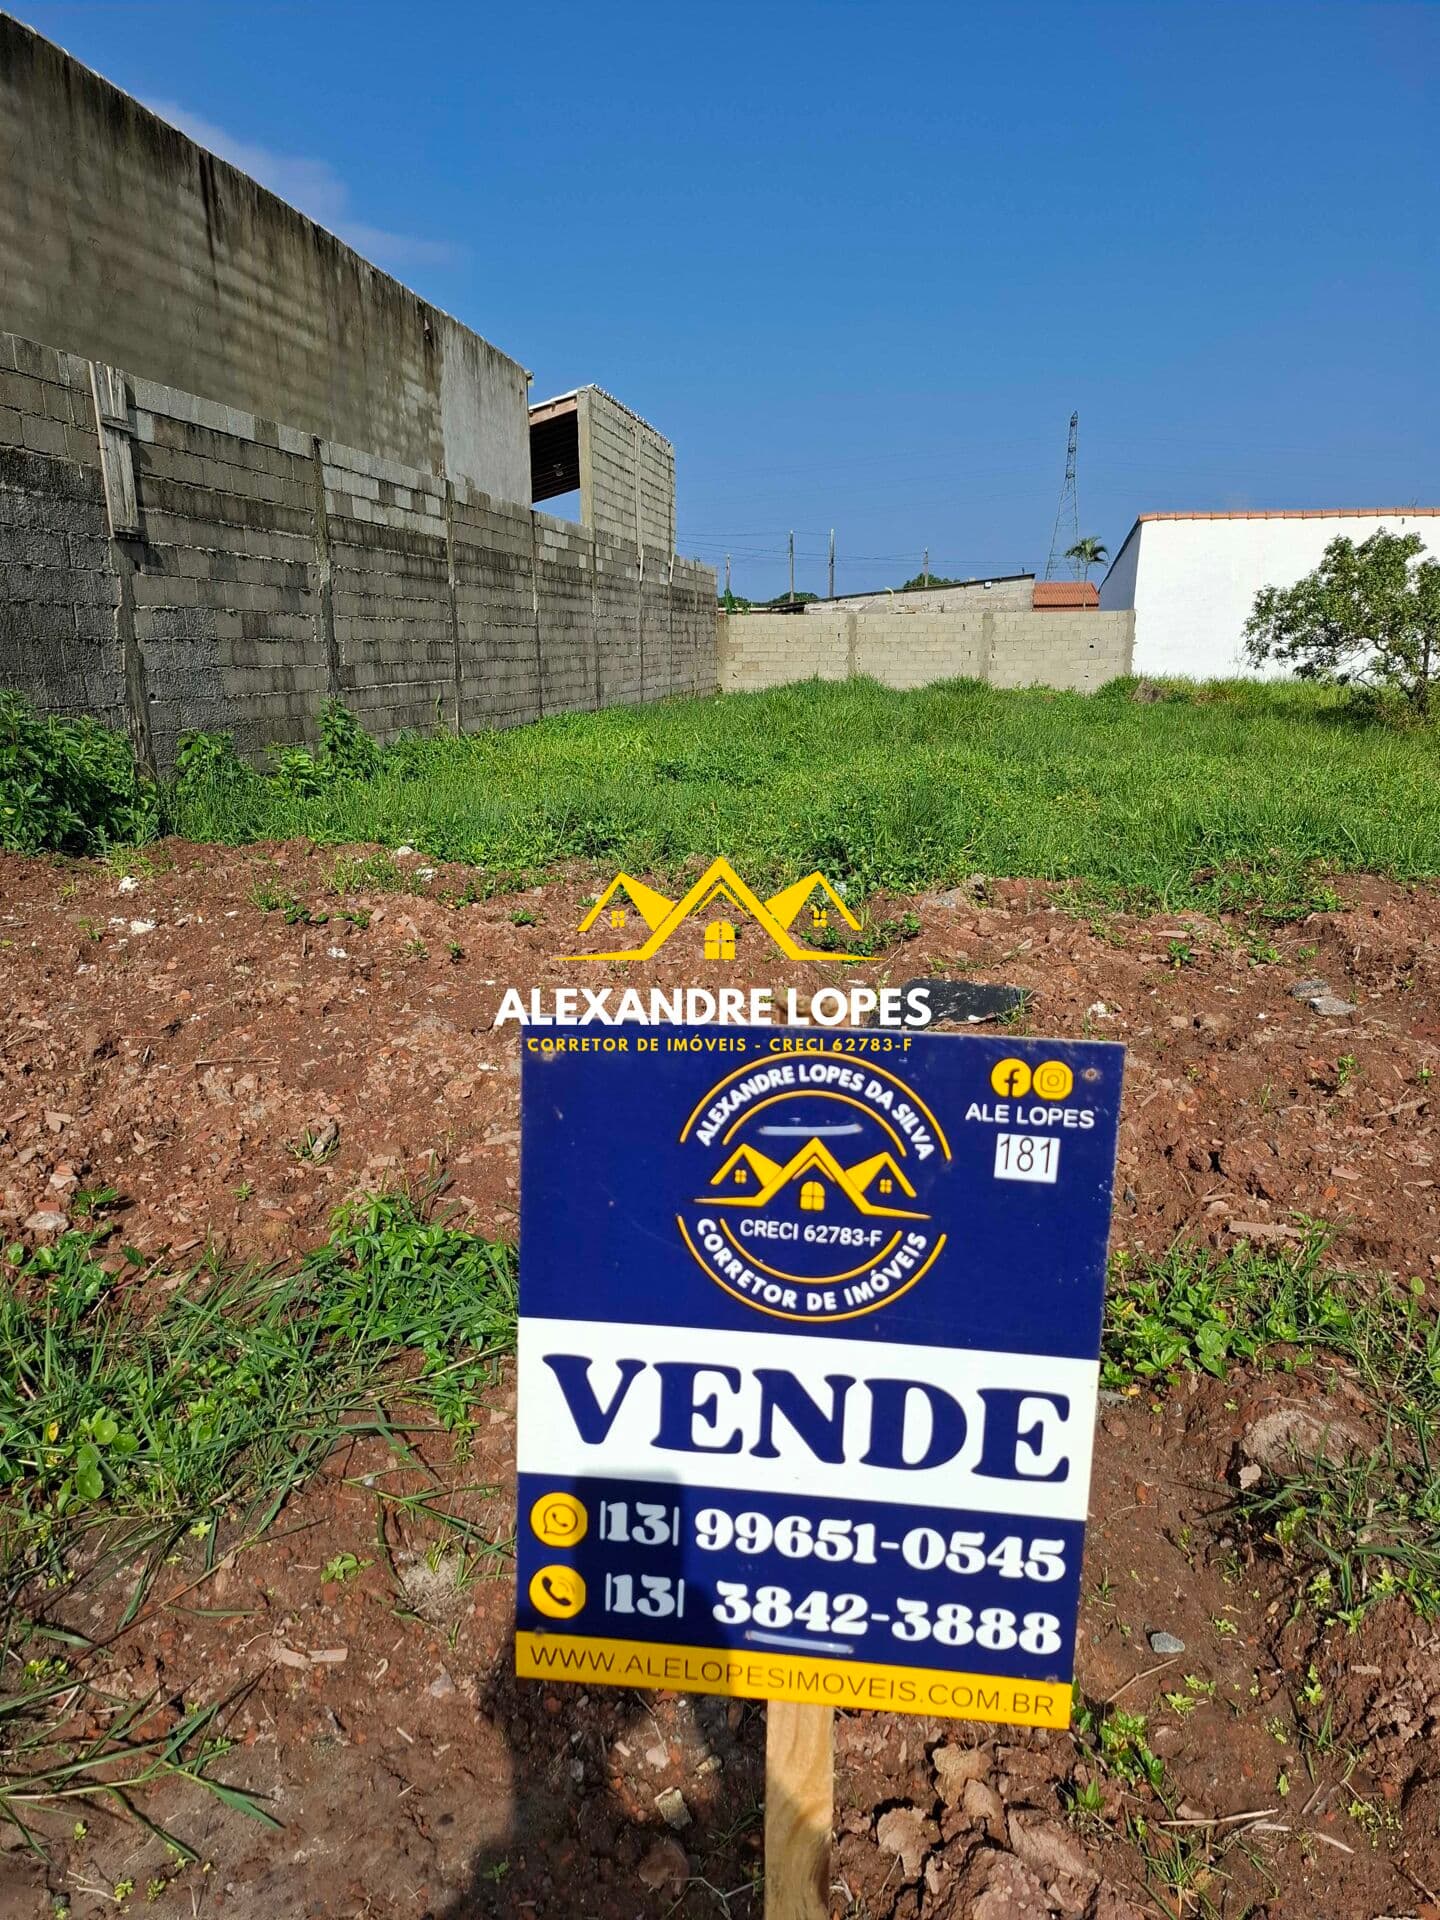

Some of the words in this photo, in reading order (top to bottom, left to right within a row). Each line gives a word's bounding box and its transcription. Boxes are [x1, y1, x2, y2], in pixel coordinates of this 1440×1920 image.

[696, 1065, 795, 1147] ALEXANDRE
[798, 1063, 866, 1092] LOPES
[864, 1080, 894, 1110] DA
[891, 1103, 935, 1161] SILVA
[965, 1102, 1010, 1124] ALE
[1016, 1105, 1095, 1129] LOPES
[1000, 1134, 1051, 1174] 181
[697, 1218, 798, 1312] CORRETOR
[806, 1292, 837, 1311] DE
[843, 1232, 927, 1306] IMÓVEIS
[740, 1219, 798, 1240] CRECI
[803, 1224, 882, 1247] 62783-F
[542, 1353, 1070, 1483] VENDE
[694, 1507, 1066, 1582] 99651-0545
[712, 1580, 1062, 1655] 3842-3888
[530, 1645, 1054, 1717] WWW.ALELOPESIMOVEIS.COM.BR
